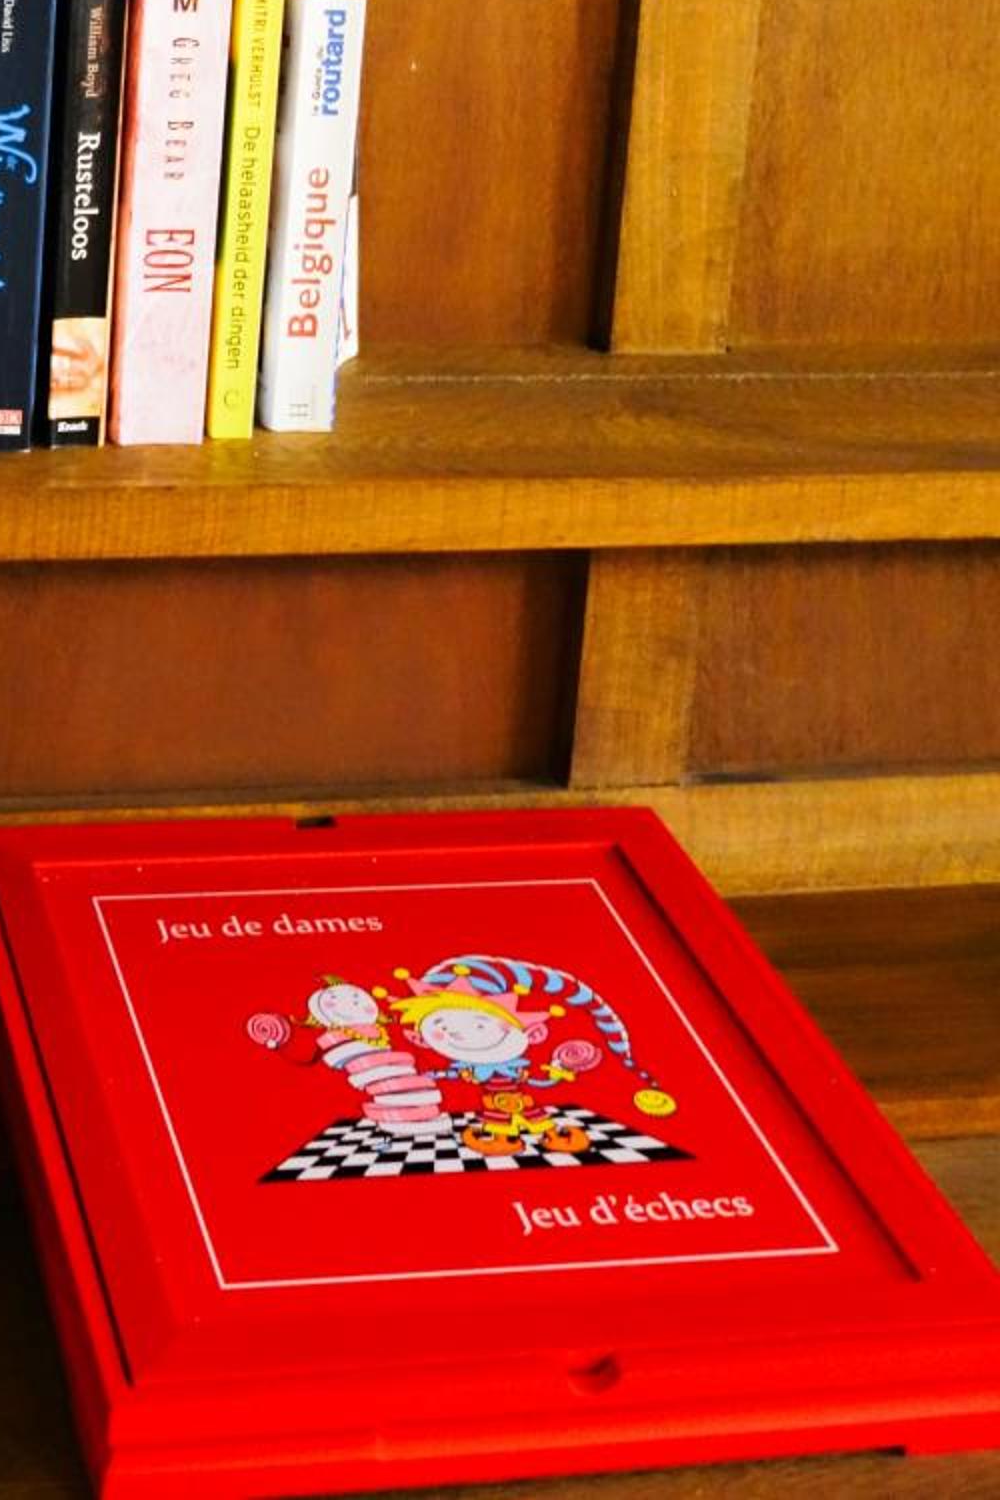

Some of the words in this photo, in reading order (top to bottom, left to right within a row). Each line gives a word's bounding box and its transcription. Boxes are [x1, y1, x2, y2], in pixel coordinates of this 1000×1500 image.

[0, 26, 14, 53] Liss
[86, 6, 104, 60] William
[319, 9, 348, 117] routard
[80, 62, 100, 98] Boyd
[169, 37, 201, 98] GREG
[247, 38, 266, 109] VERHULST
[163, 121, 196, 181] BEAR
[243, 126, 262, 152] De
[71, 131, 102, 260] Rusteloos
[232, 157, 260, 263] helaasheid
[142, 229, 196, 293] EON
[286, 166, 336, 339] Belgique
[230, 268, 249, 300] der
[223, 305, 246, 371] dingen
[157, 918, 213, 944] Jeu
[222, 915, 263, 938] de
[273, 912, 383, 936] dames
[512, 1201, 582, 1236] Jeu
